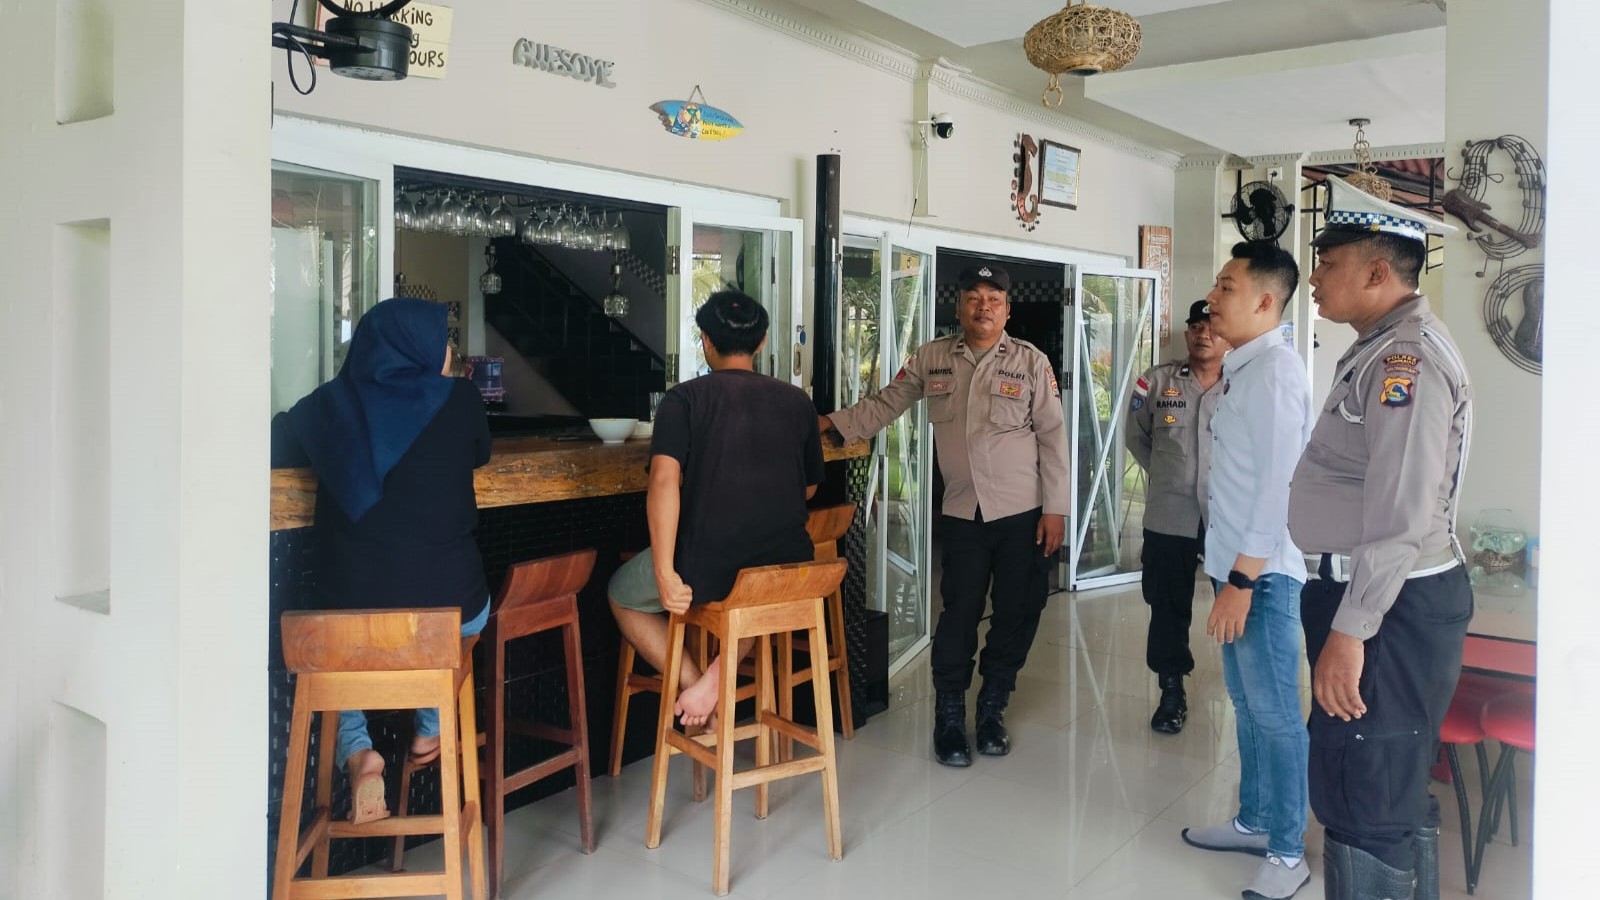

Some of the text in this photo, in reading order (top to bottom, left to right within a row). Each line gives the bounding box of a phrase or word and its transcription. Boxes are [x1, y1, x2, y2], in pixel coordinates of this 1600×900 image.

[369, 1, 433, 27] WRKING
[409, 50, 445, 68] OURS
[512, 37, 617, 89] AWESOME
[998, 369, 1025, 381] POLRI
[1156, 400, 1187, 409] RAHADI
